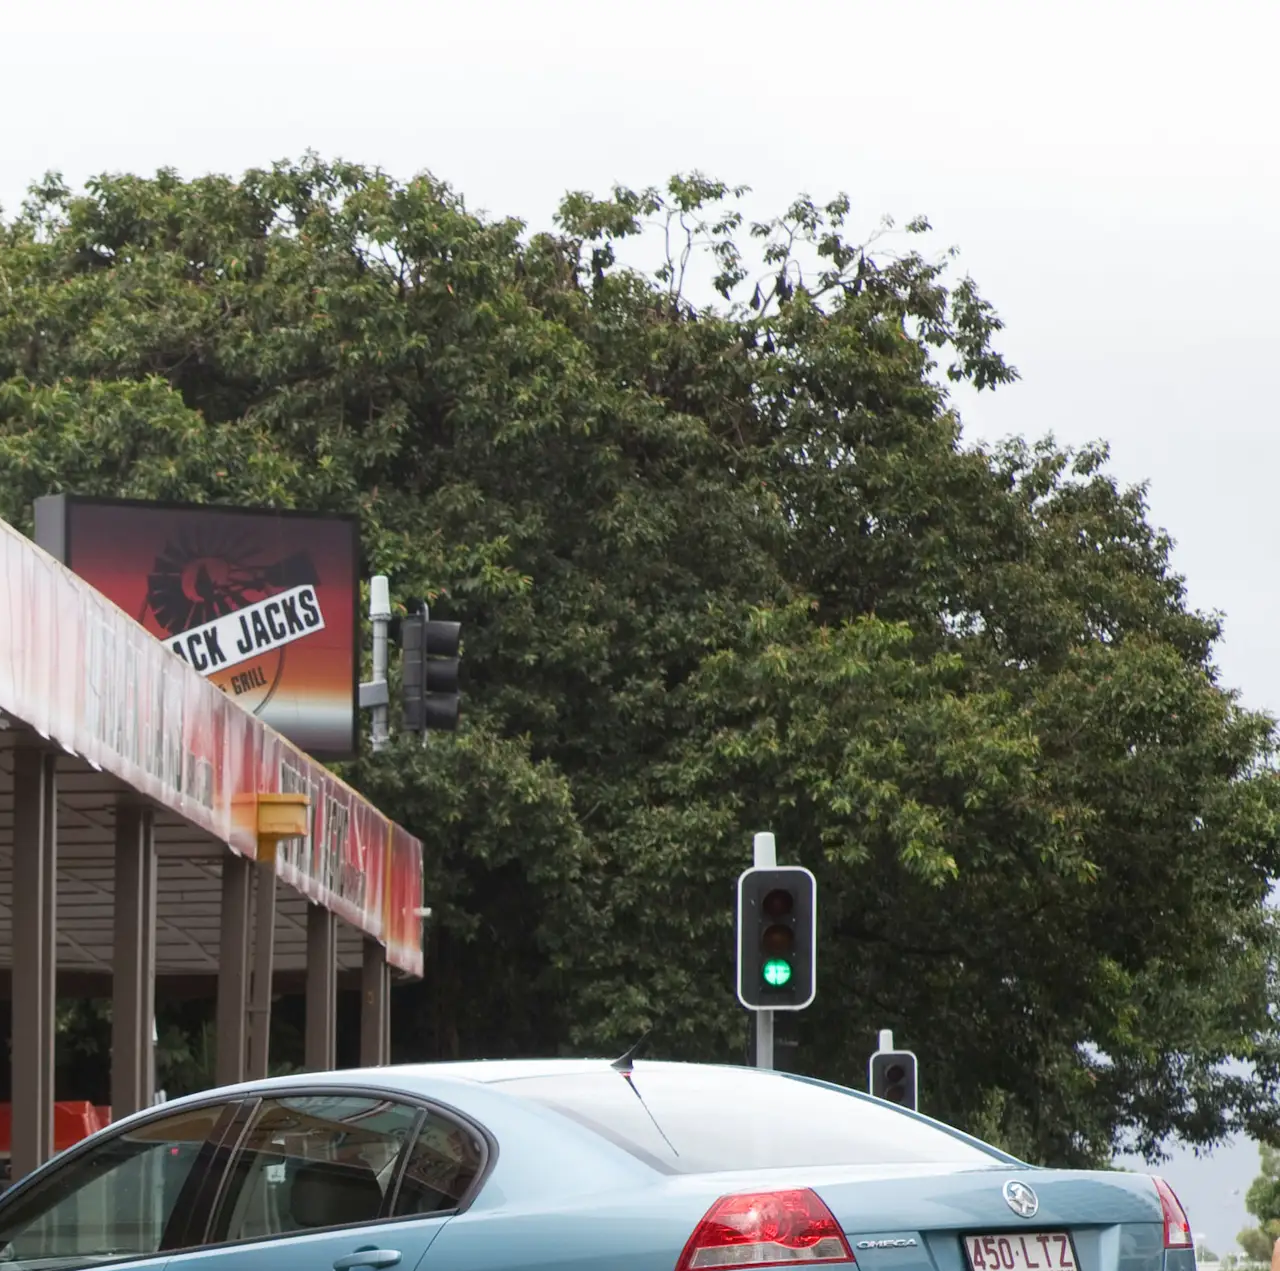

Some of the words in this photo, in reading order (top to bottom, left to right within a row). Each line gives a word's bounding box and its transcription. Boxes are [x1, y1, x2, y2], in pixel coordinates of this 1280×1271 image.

[236, 589, 320, 655] JACKS
[231, 667, 267, 696] GRILL
[856, 1238, 918, 1251] OMEGA
